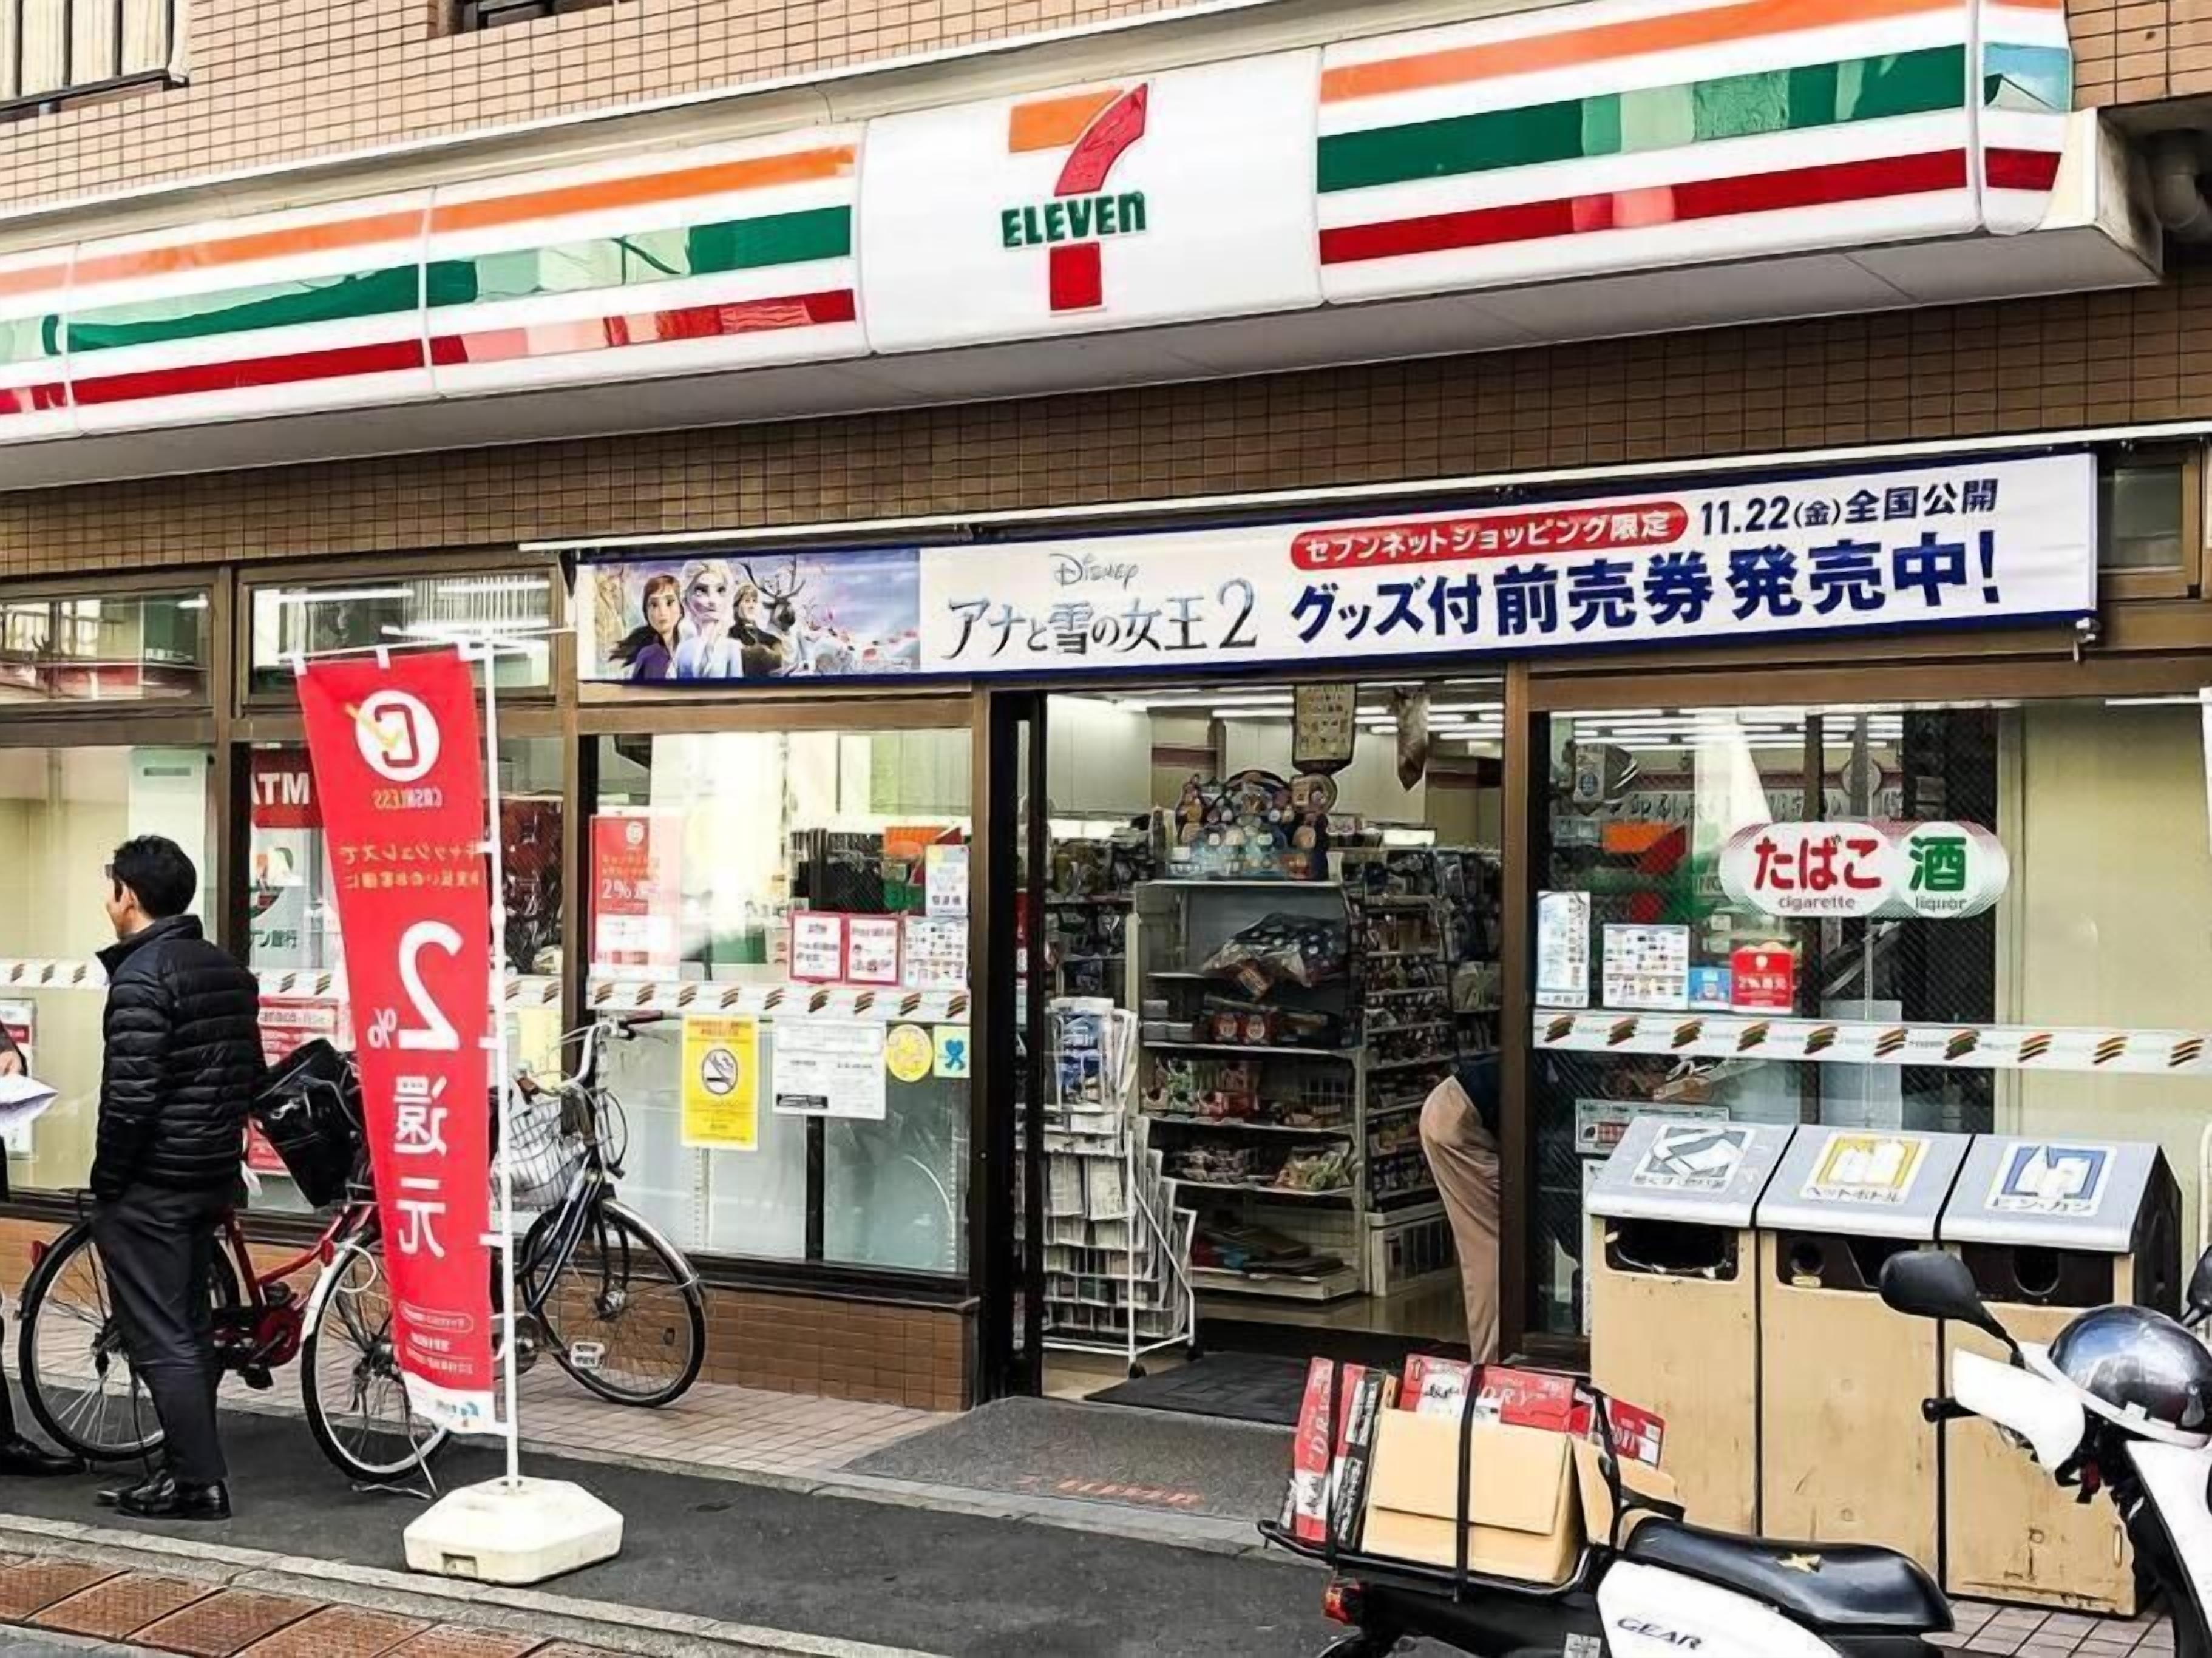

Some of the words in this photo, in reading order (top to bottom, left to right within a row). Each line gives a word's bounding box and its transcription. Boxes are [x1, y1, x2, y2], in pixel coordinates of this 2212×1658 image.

[1305, 510, 1671, 563] セブンネットショッピング限定
[1754, 836, 1881, 891] たばこ
[1909, 836, 1967, 891] 酒
[1778, 896, 1856, 911] cigarette
[1915, 895, 1967, 912] liquor
[1617, 1616, 1702, 1650] GEAR
